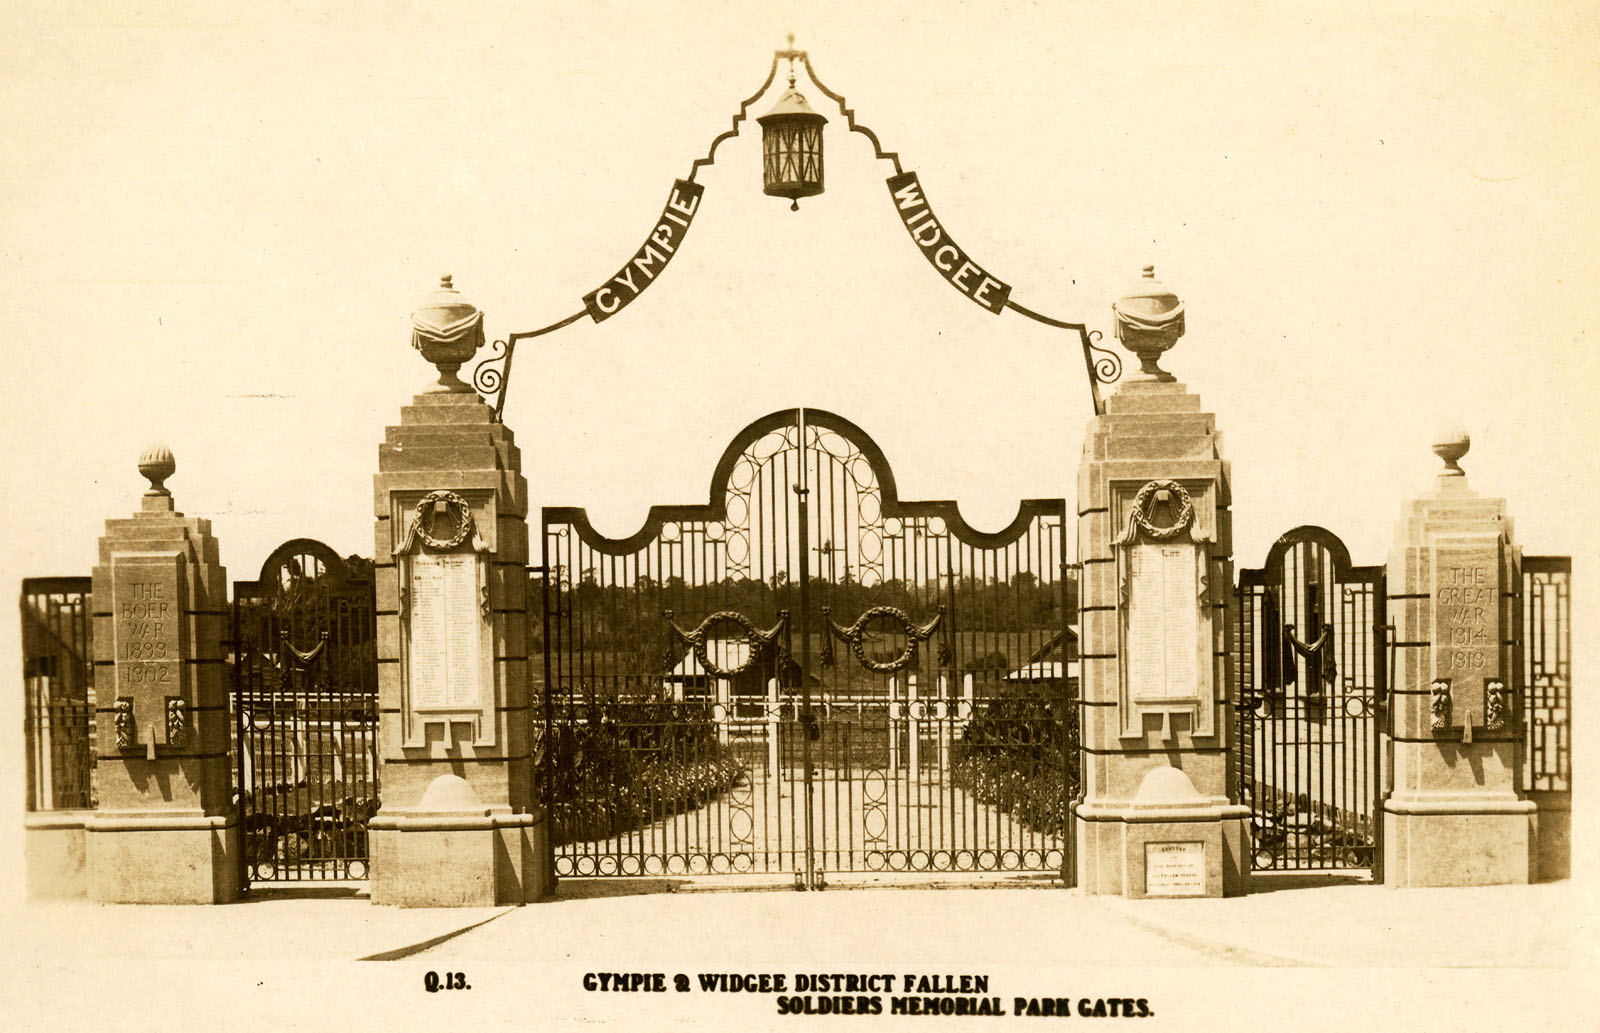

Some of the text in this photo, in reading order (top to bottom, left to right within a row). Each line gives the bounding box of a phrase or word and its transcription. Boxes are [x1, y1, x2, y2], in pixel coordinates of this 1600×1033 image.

[1450, 567, 1485, 585] THE
[128, 582, 165, 600] THE
[1438, 587, 1497, 606] GREAT
[122, 602, 171, 621] BOER
[1448, 606, 1487, 626] WAR
[128, 622, 165, 641] WAR
[1449, 627, 1487, 646] 1914
[126, 641, 168, 660] 1899
[1450, 651, 1485, 670] 1919
[127, 665, 171, 683] 1902
